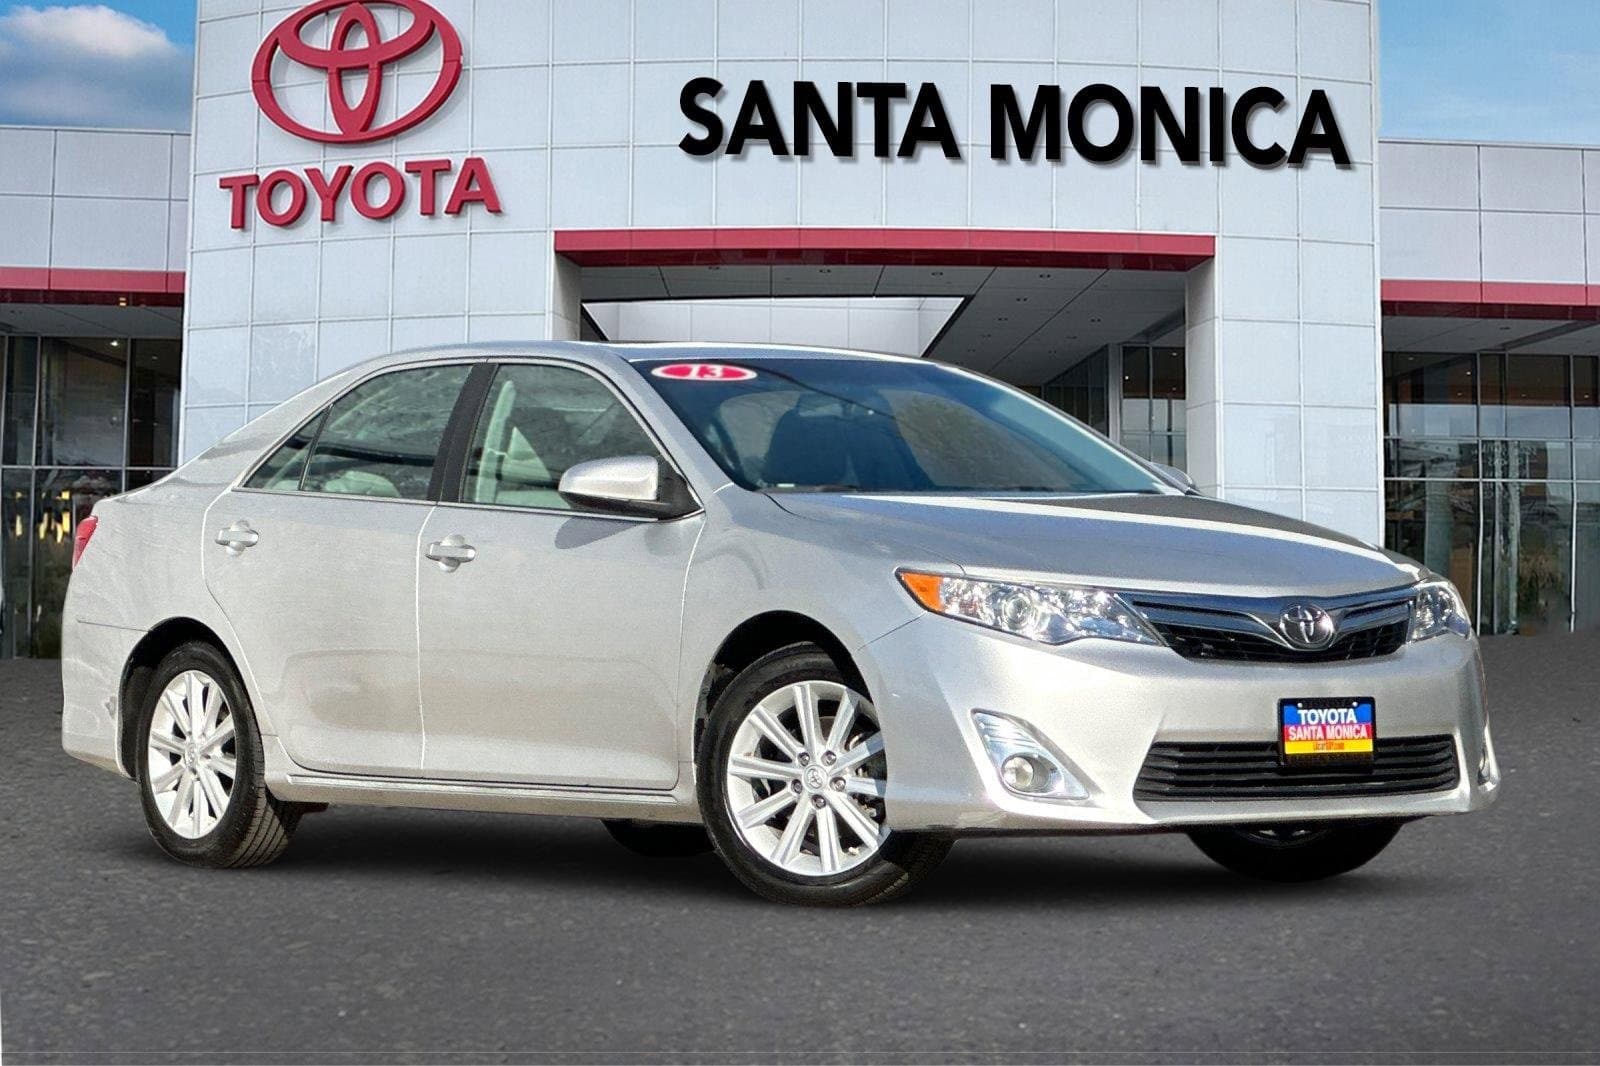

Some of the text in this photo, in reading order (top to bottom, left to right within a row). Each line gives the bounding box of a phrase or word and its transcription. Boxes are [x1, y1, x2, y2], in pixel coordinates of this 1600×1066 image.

[678, 76, 1351, 169] SANTA MONICA
[219, 157, 502, 230] TOYOTA
[1288, 724, 1368, 740] SANTA MONICA
[1298, 708, 1357, 725] TOYOTA
